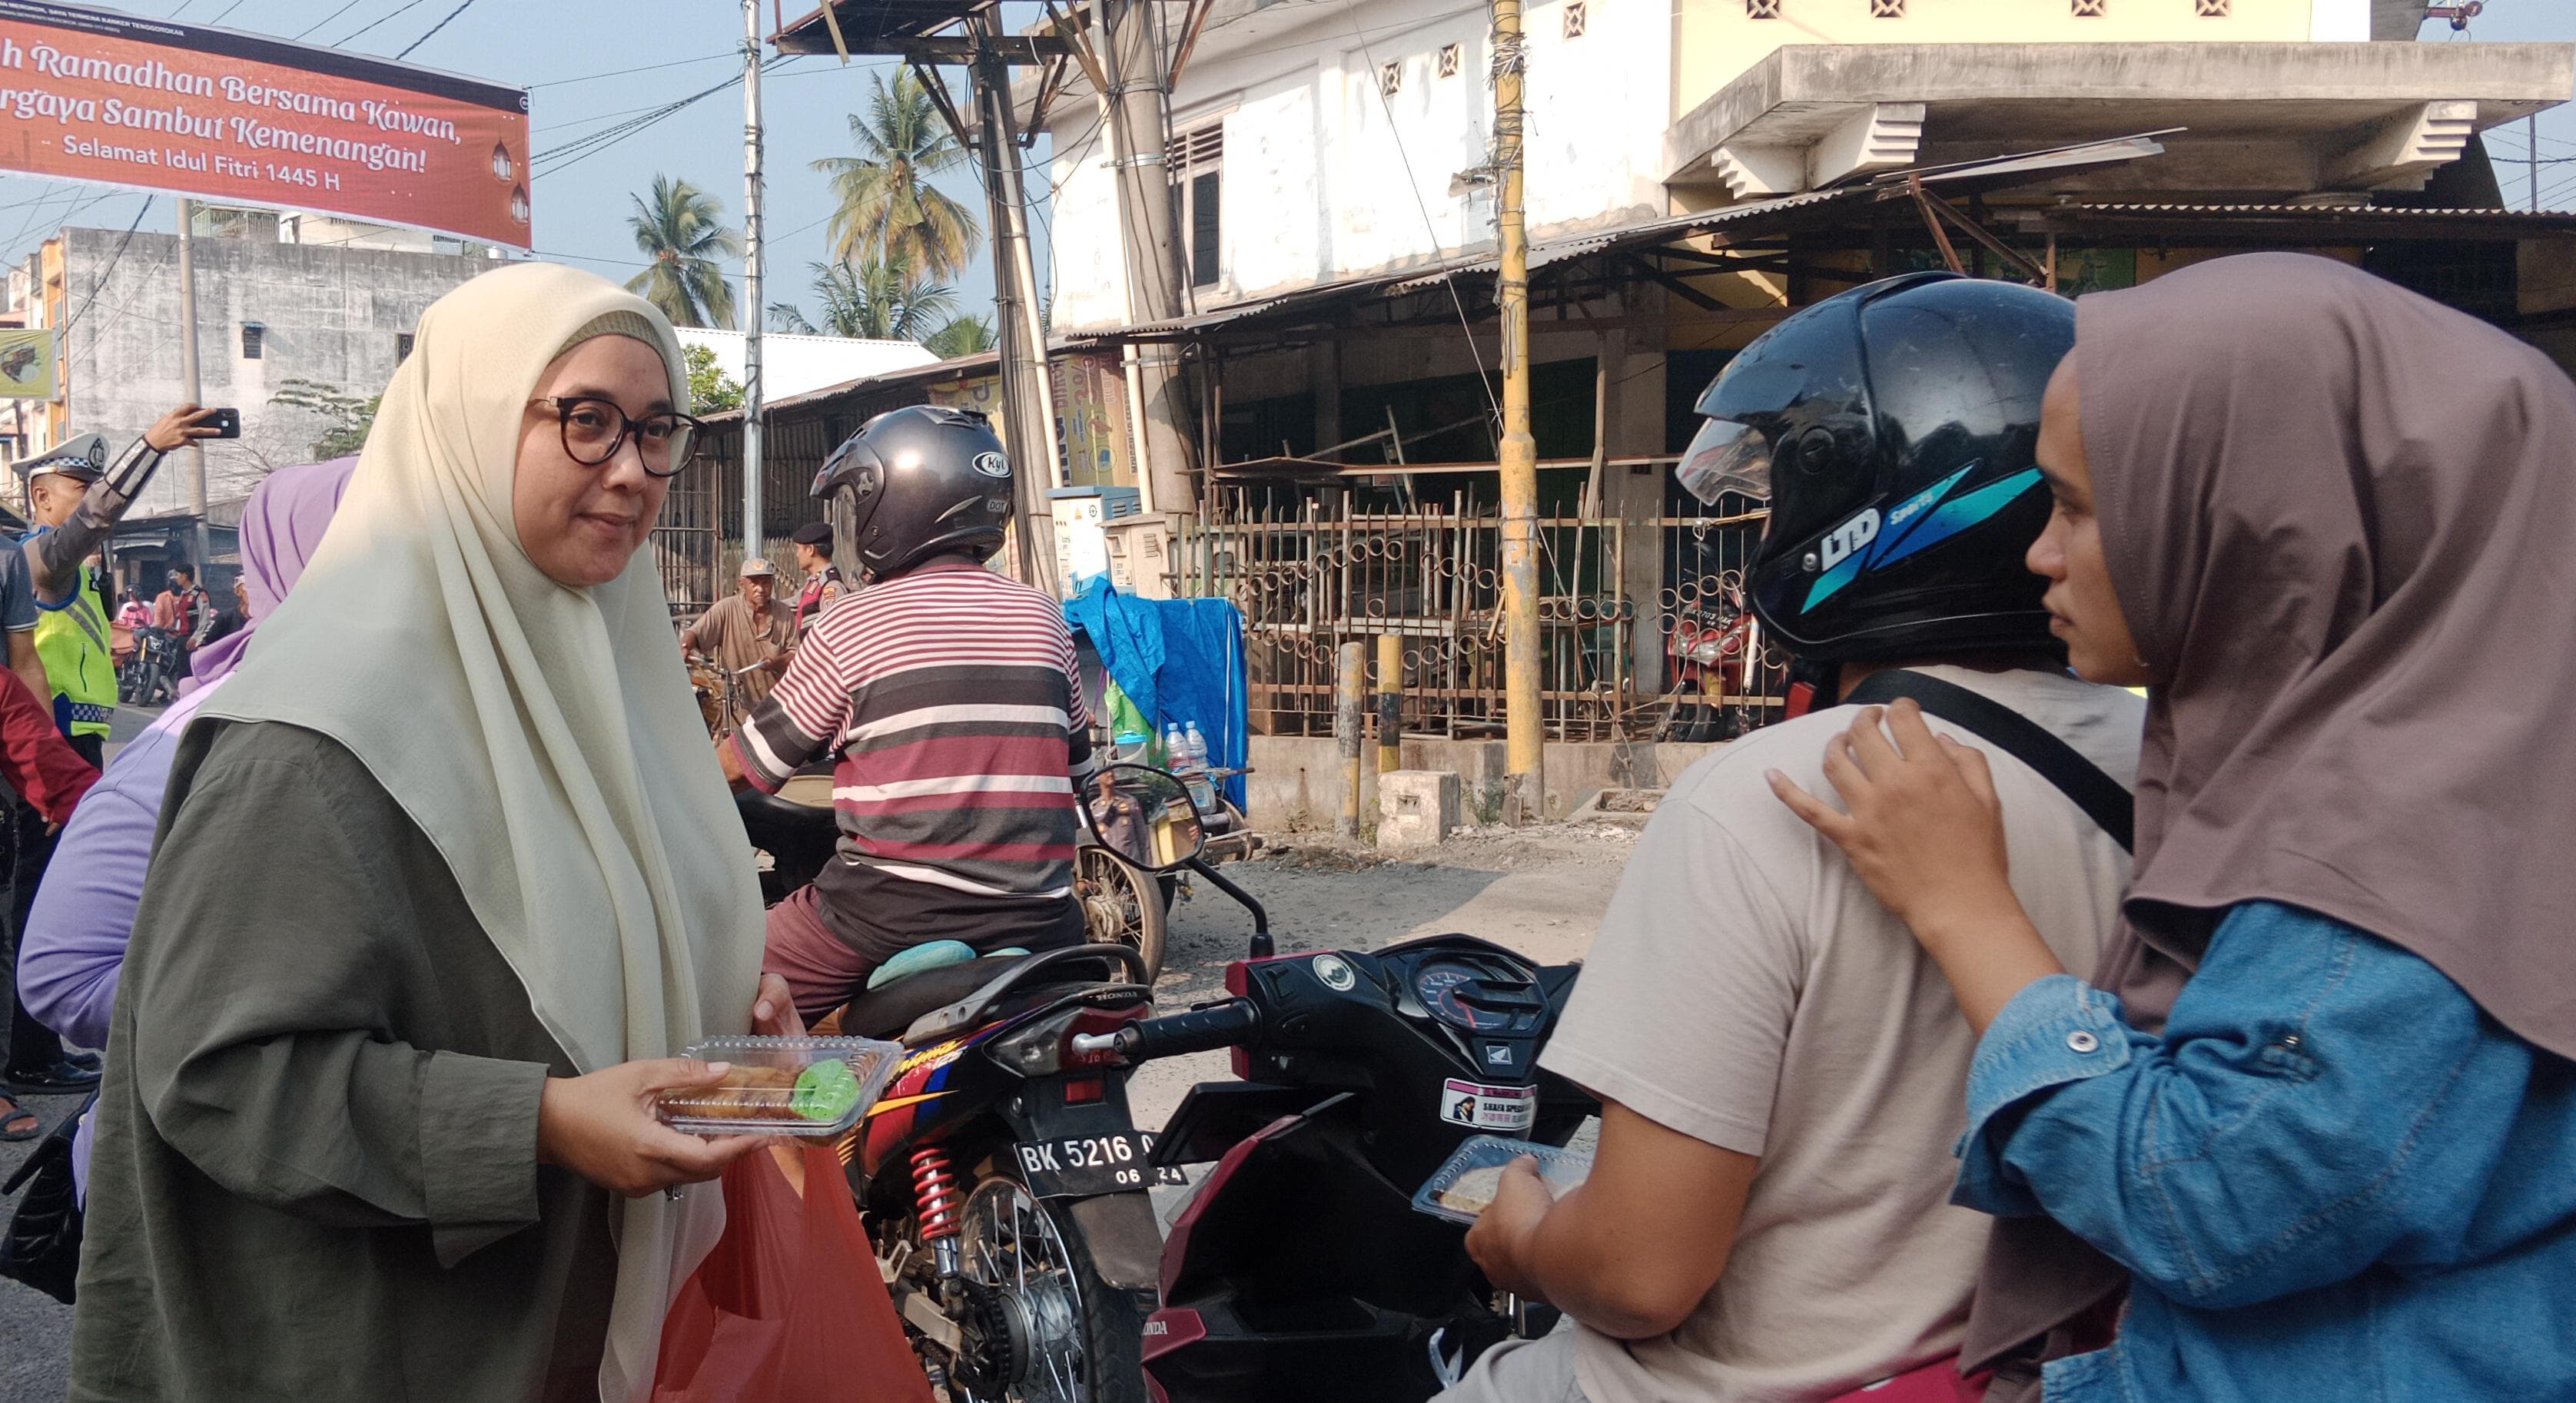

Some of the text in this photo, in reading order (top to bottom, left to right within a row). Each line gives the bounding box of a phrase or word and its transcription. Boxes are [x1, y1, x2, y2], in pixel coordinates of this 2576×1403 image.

[68, 12, 101, 22] TERKENA
[101, 17, 131, 28] KANKER
[30, 46, 213, 98] Ramadhan
[220, 75, 355, 121] Bersama
[361, 99, 461, 144] Kawan,
[101, 98, 224, 134] Sambut
[230, 116, 427, 173] Kemenangan!
[63, 134, 340, 191] Selamat Idul Fitri 1445 H
[990, 501, 1005, 511] DOT
[1821, 507, 1882, 572] LTD
[1021, 1143, 1062, 1172] BK
[1064, 1136, 1133, 1168] 5216
[1115, 1166, 1182, 1184] 06 24
